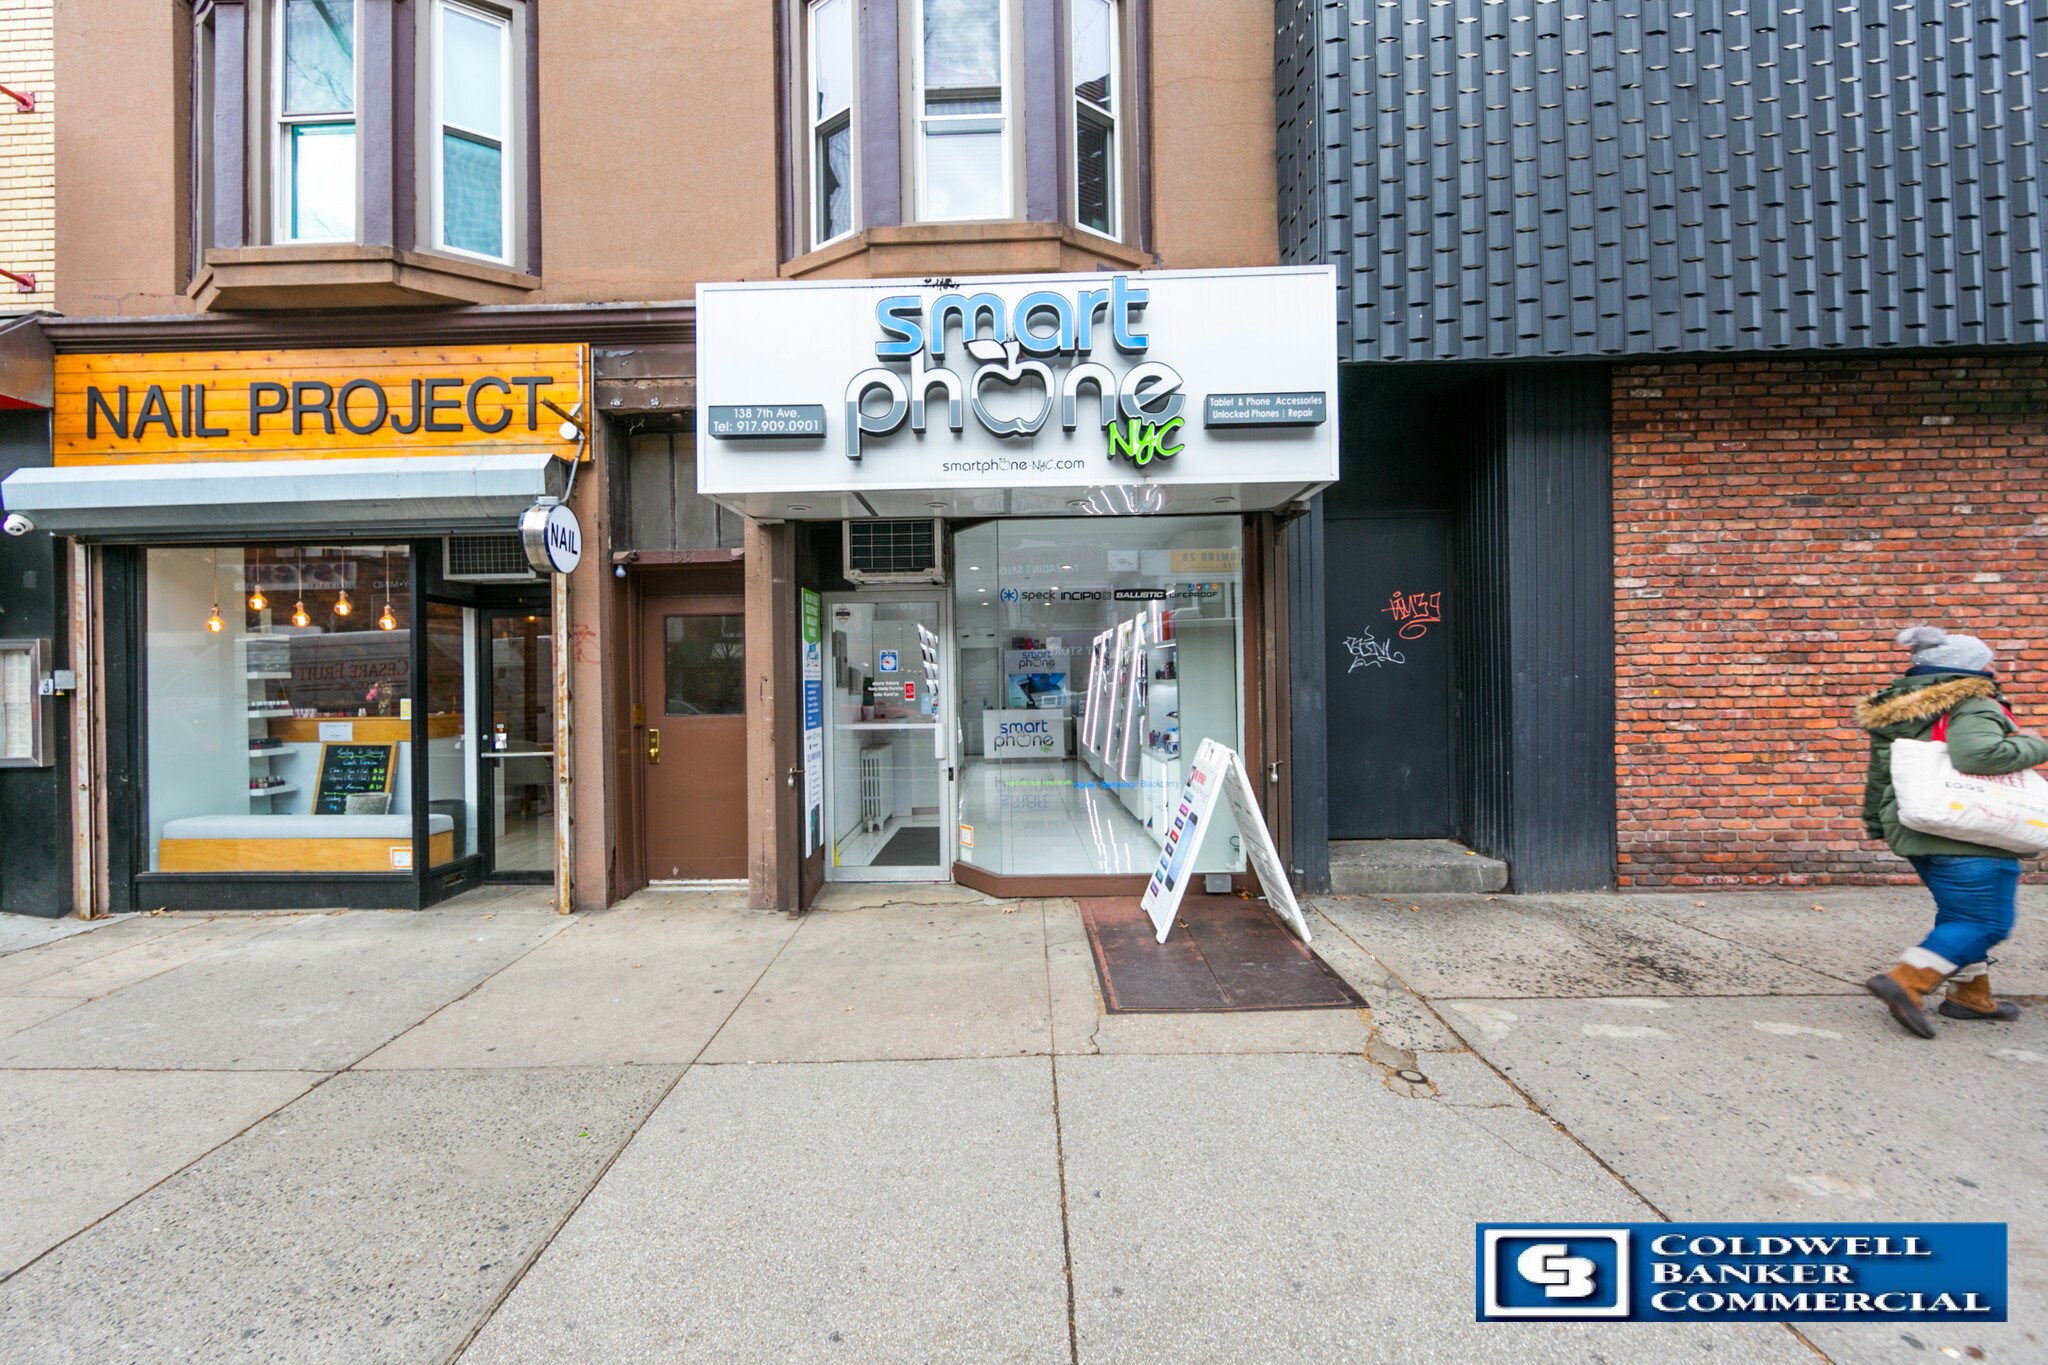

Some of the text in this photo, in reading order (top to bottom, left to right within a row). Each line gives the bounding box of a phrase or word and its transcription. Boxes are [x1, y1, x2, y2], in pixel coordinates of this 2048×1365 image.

[875, 276, 1149, 361] smart
[1210, 395, 1322, 407] Tablet & Phone Accessories
[87, 376, 553, 439] NAIL PROJECT
[734, 407, 800, 419] 138 7th Ave.
[1213, 408, 1313, 419] Unlocked Phones Repair
[713, 420, 819, 432] Tel: 917.909.0901
[551, 523, 578, 555] NAIL
[1021, 590, 1218, 601] speck INCIPIO BALLISTIC LIFEPROOF
[1022, 650, 1053, 659] smart
[1000, 720, 1048, 733] smart
[994, 734, 1054, 751] phone
[1101, 780, 1137, 790] Samsung
[1945, 781, 1985, 792] EGGS
